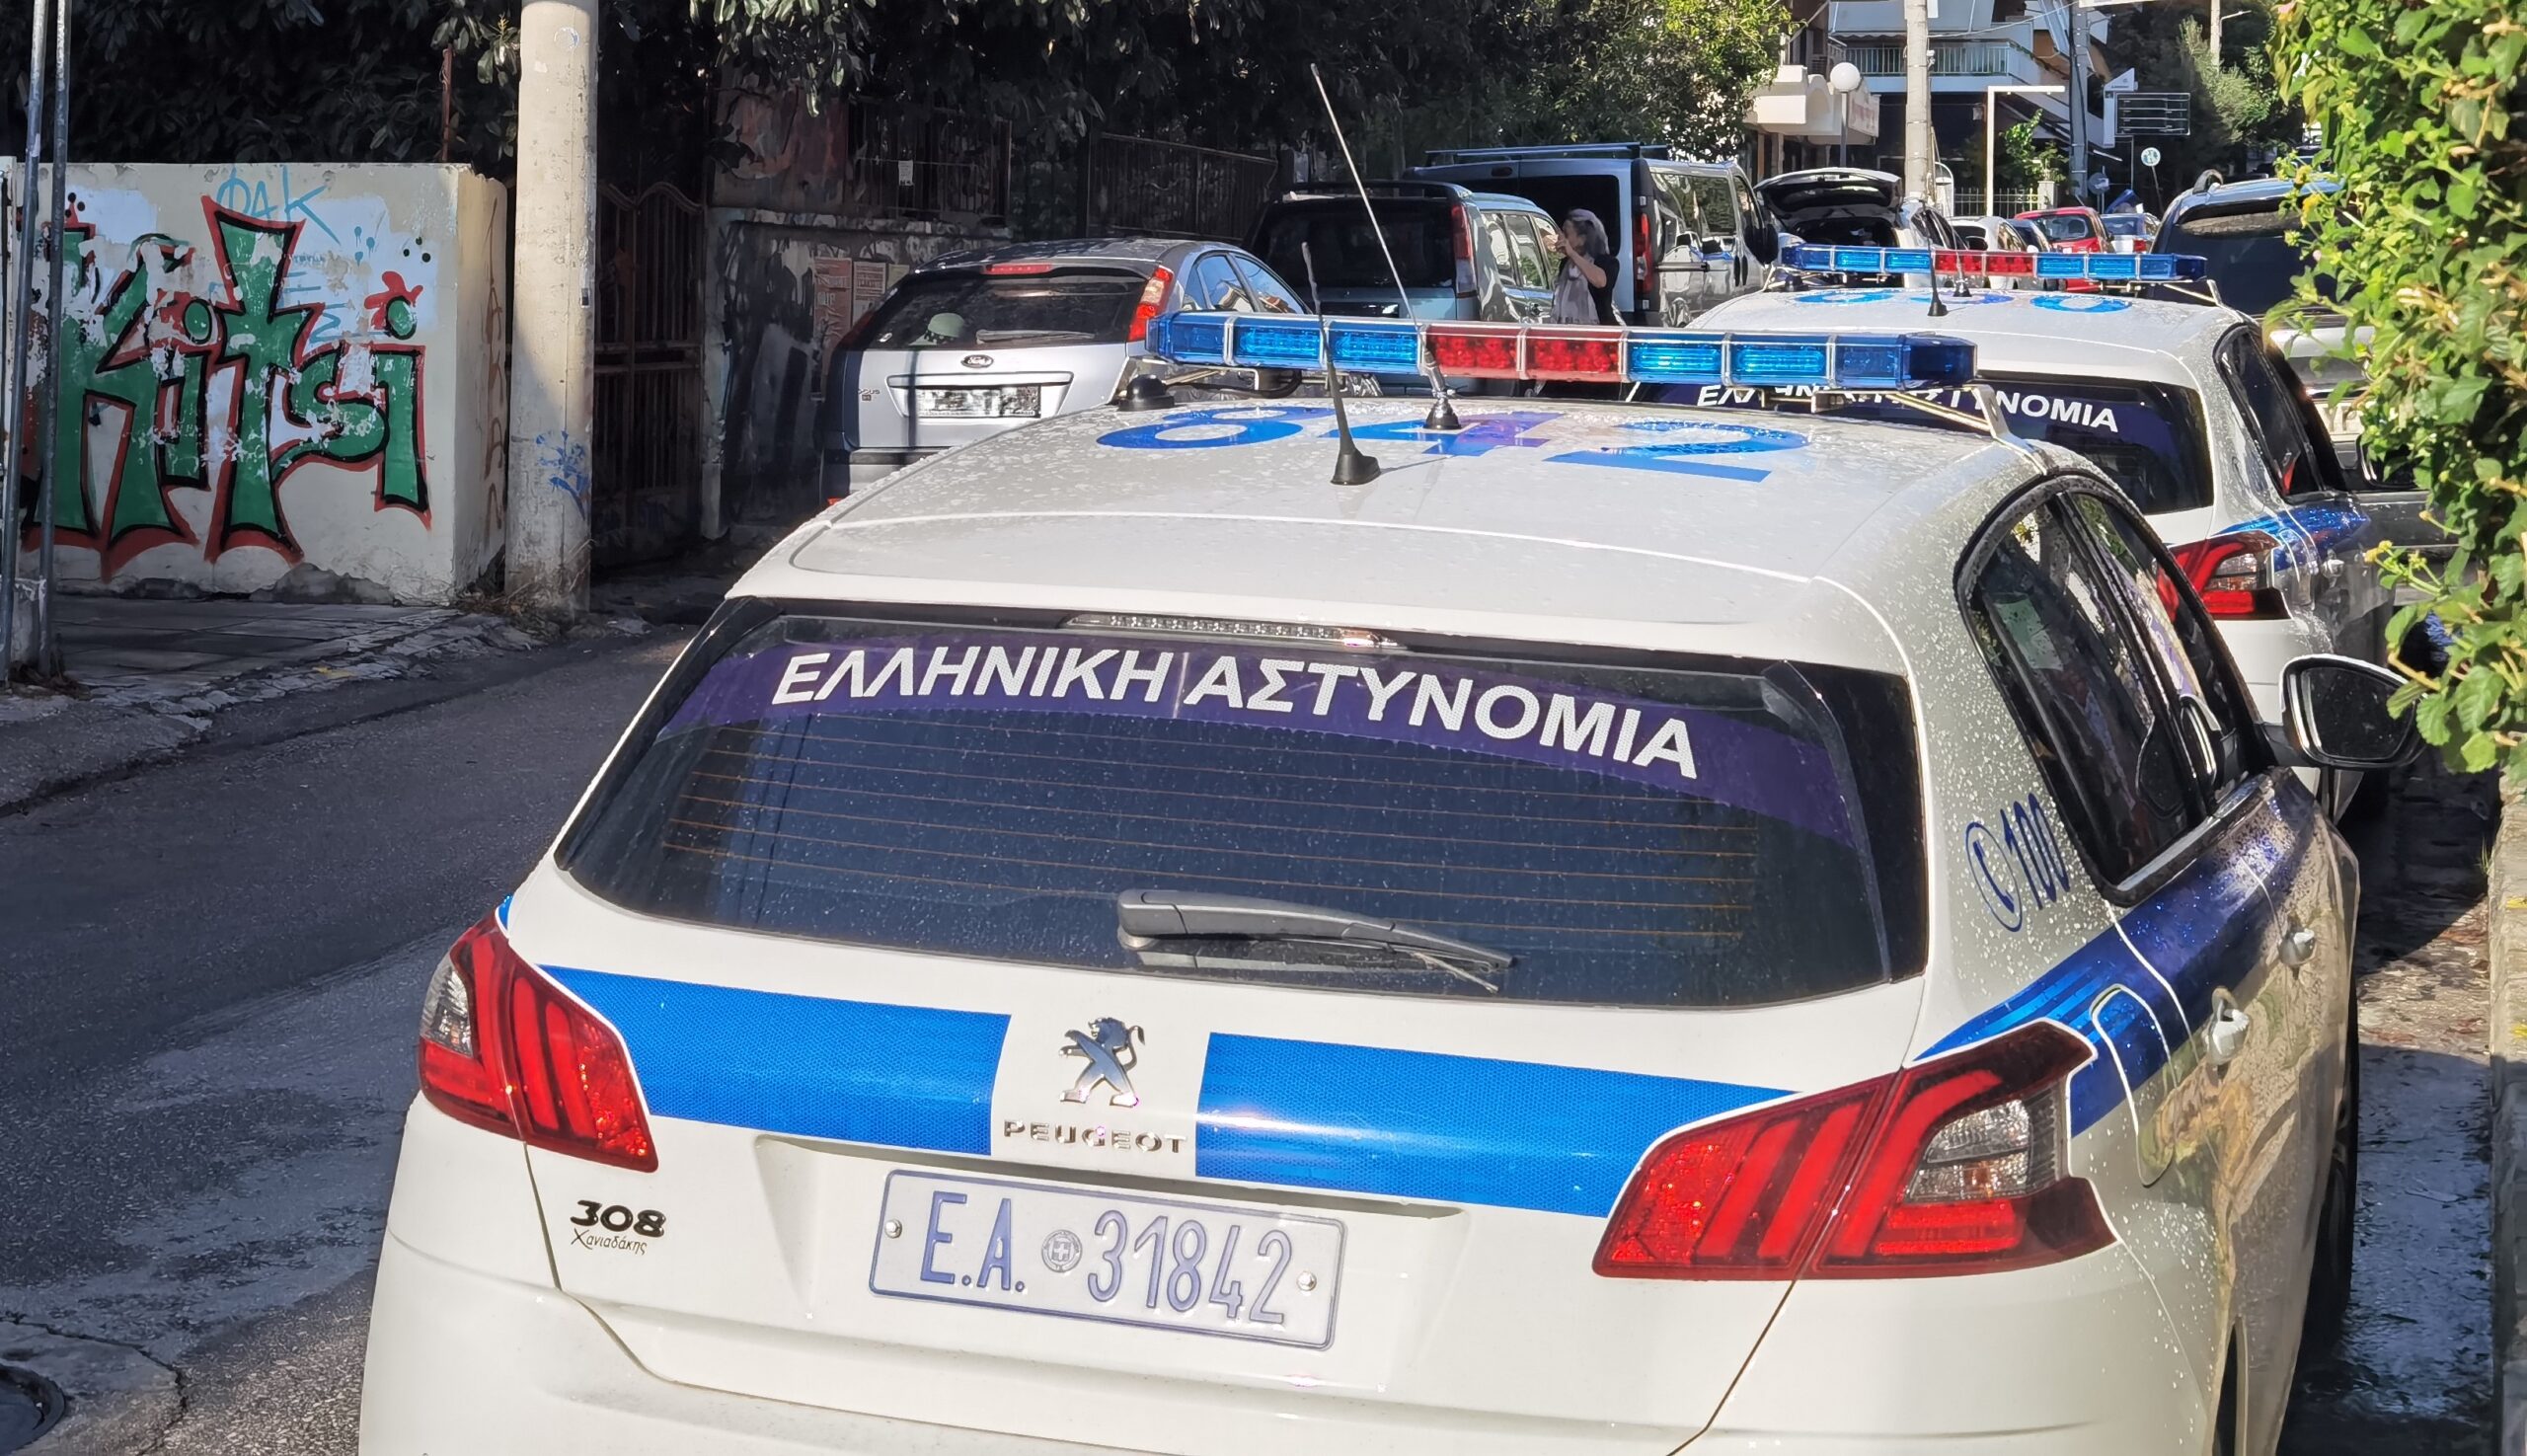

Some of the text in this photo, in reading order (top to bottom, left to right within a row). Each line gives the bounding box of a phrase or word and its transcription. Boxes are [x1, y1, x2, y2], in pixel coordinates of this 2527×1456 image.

[772, 647, 1698, 779] ΕΛΛΗΝΙΚΗ ΑΣΤΥΝΟΜΙΑ
[1999, 792, 2071, 910] 100
[1004, 1119, 1187, 1154] PEUGEOT
[570, 1199, 666, 1238] 308
[571, 1227, 648, 1256] Χανιαδάκης
[1088, 1209, 1293, 1325] 31842
